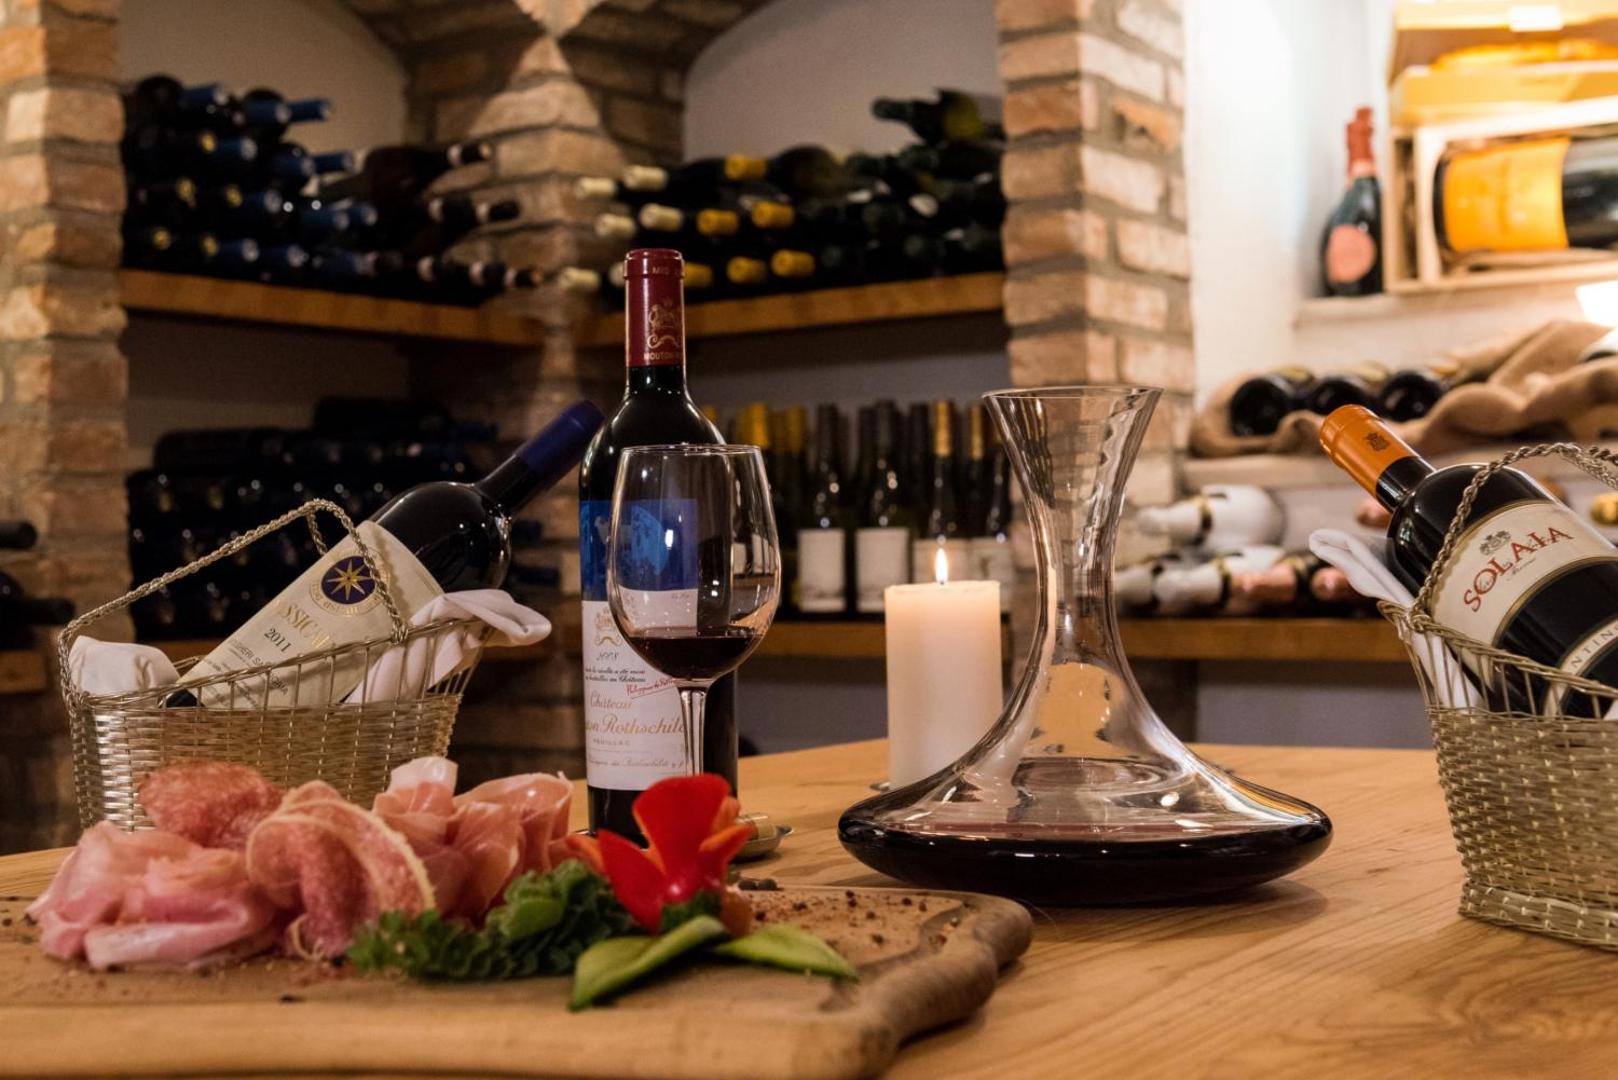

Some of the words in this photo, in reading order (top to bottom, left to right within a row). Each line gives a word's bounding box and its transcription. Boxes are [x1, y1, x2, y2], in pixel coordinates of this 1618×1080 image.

[1463, 527, 1574, 612] SOLAIA
[264, 627, 292, 652] 2011
[590, 690, 632, 709] Château
